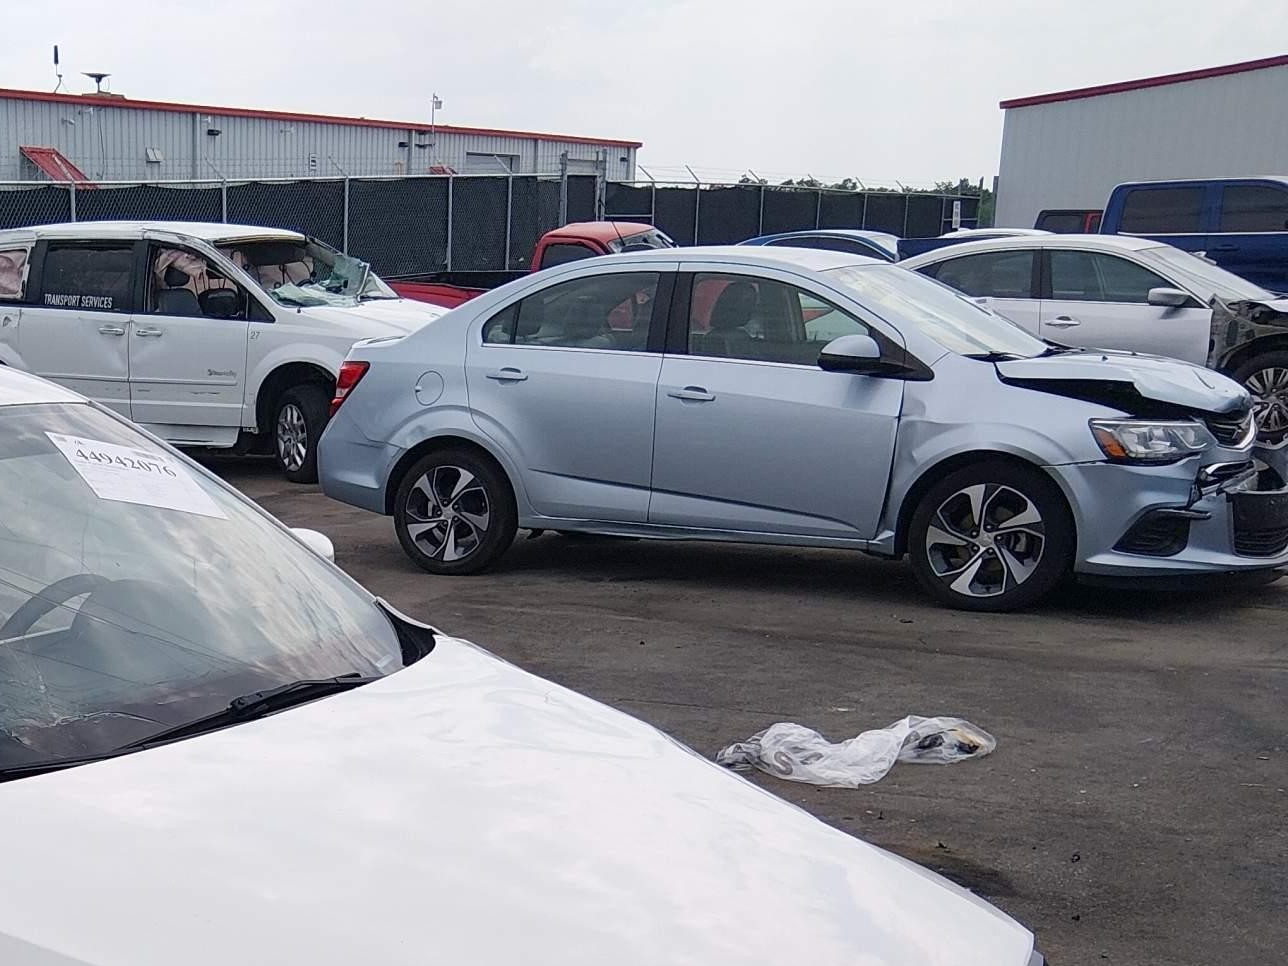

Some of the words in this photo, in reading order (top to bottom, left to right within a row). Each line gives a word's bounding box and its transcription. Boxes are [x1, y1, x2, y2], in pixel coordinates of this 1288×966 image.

[44, 293, 80, 306] TRANSPORT
[81, 295, 113, 309] SERVICES
[249, 331, 260, 340] 27
[76, 449, 177, 478] 44942076
